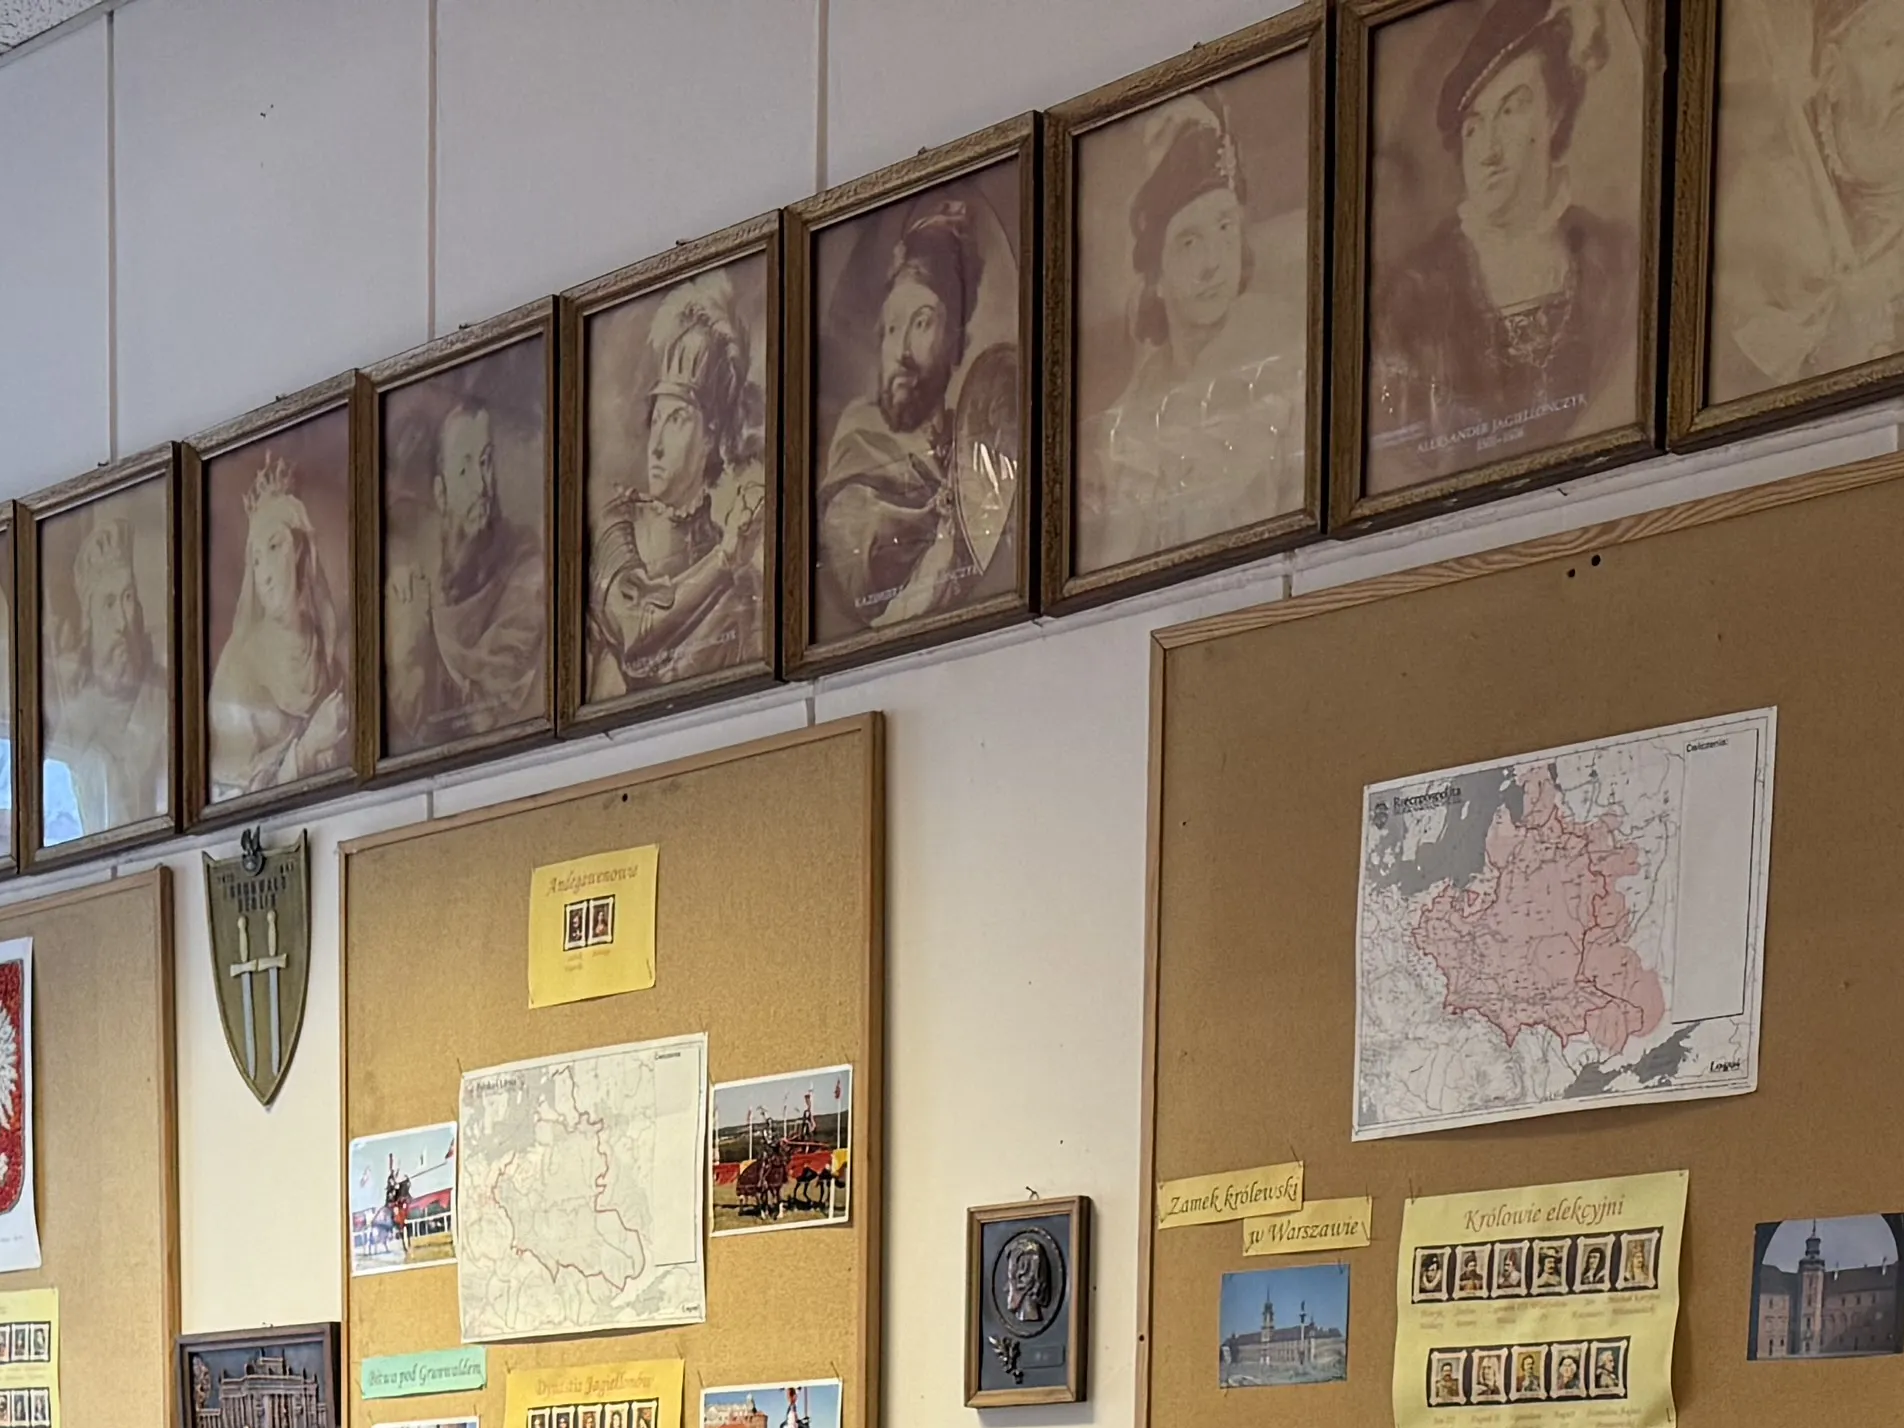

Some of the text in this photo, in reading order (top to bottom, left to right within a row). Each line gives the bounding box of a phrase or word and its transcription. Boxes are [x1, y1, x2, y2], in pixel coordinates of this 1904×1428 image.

[1168, 1176, 1298, 1215] Zamek królewski
[1464, 1194, 1626, 1232] Królowie elekcyjni
[1268, 1215, 1359, 1242] Warszawie
